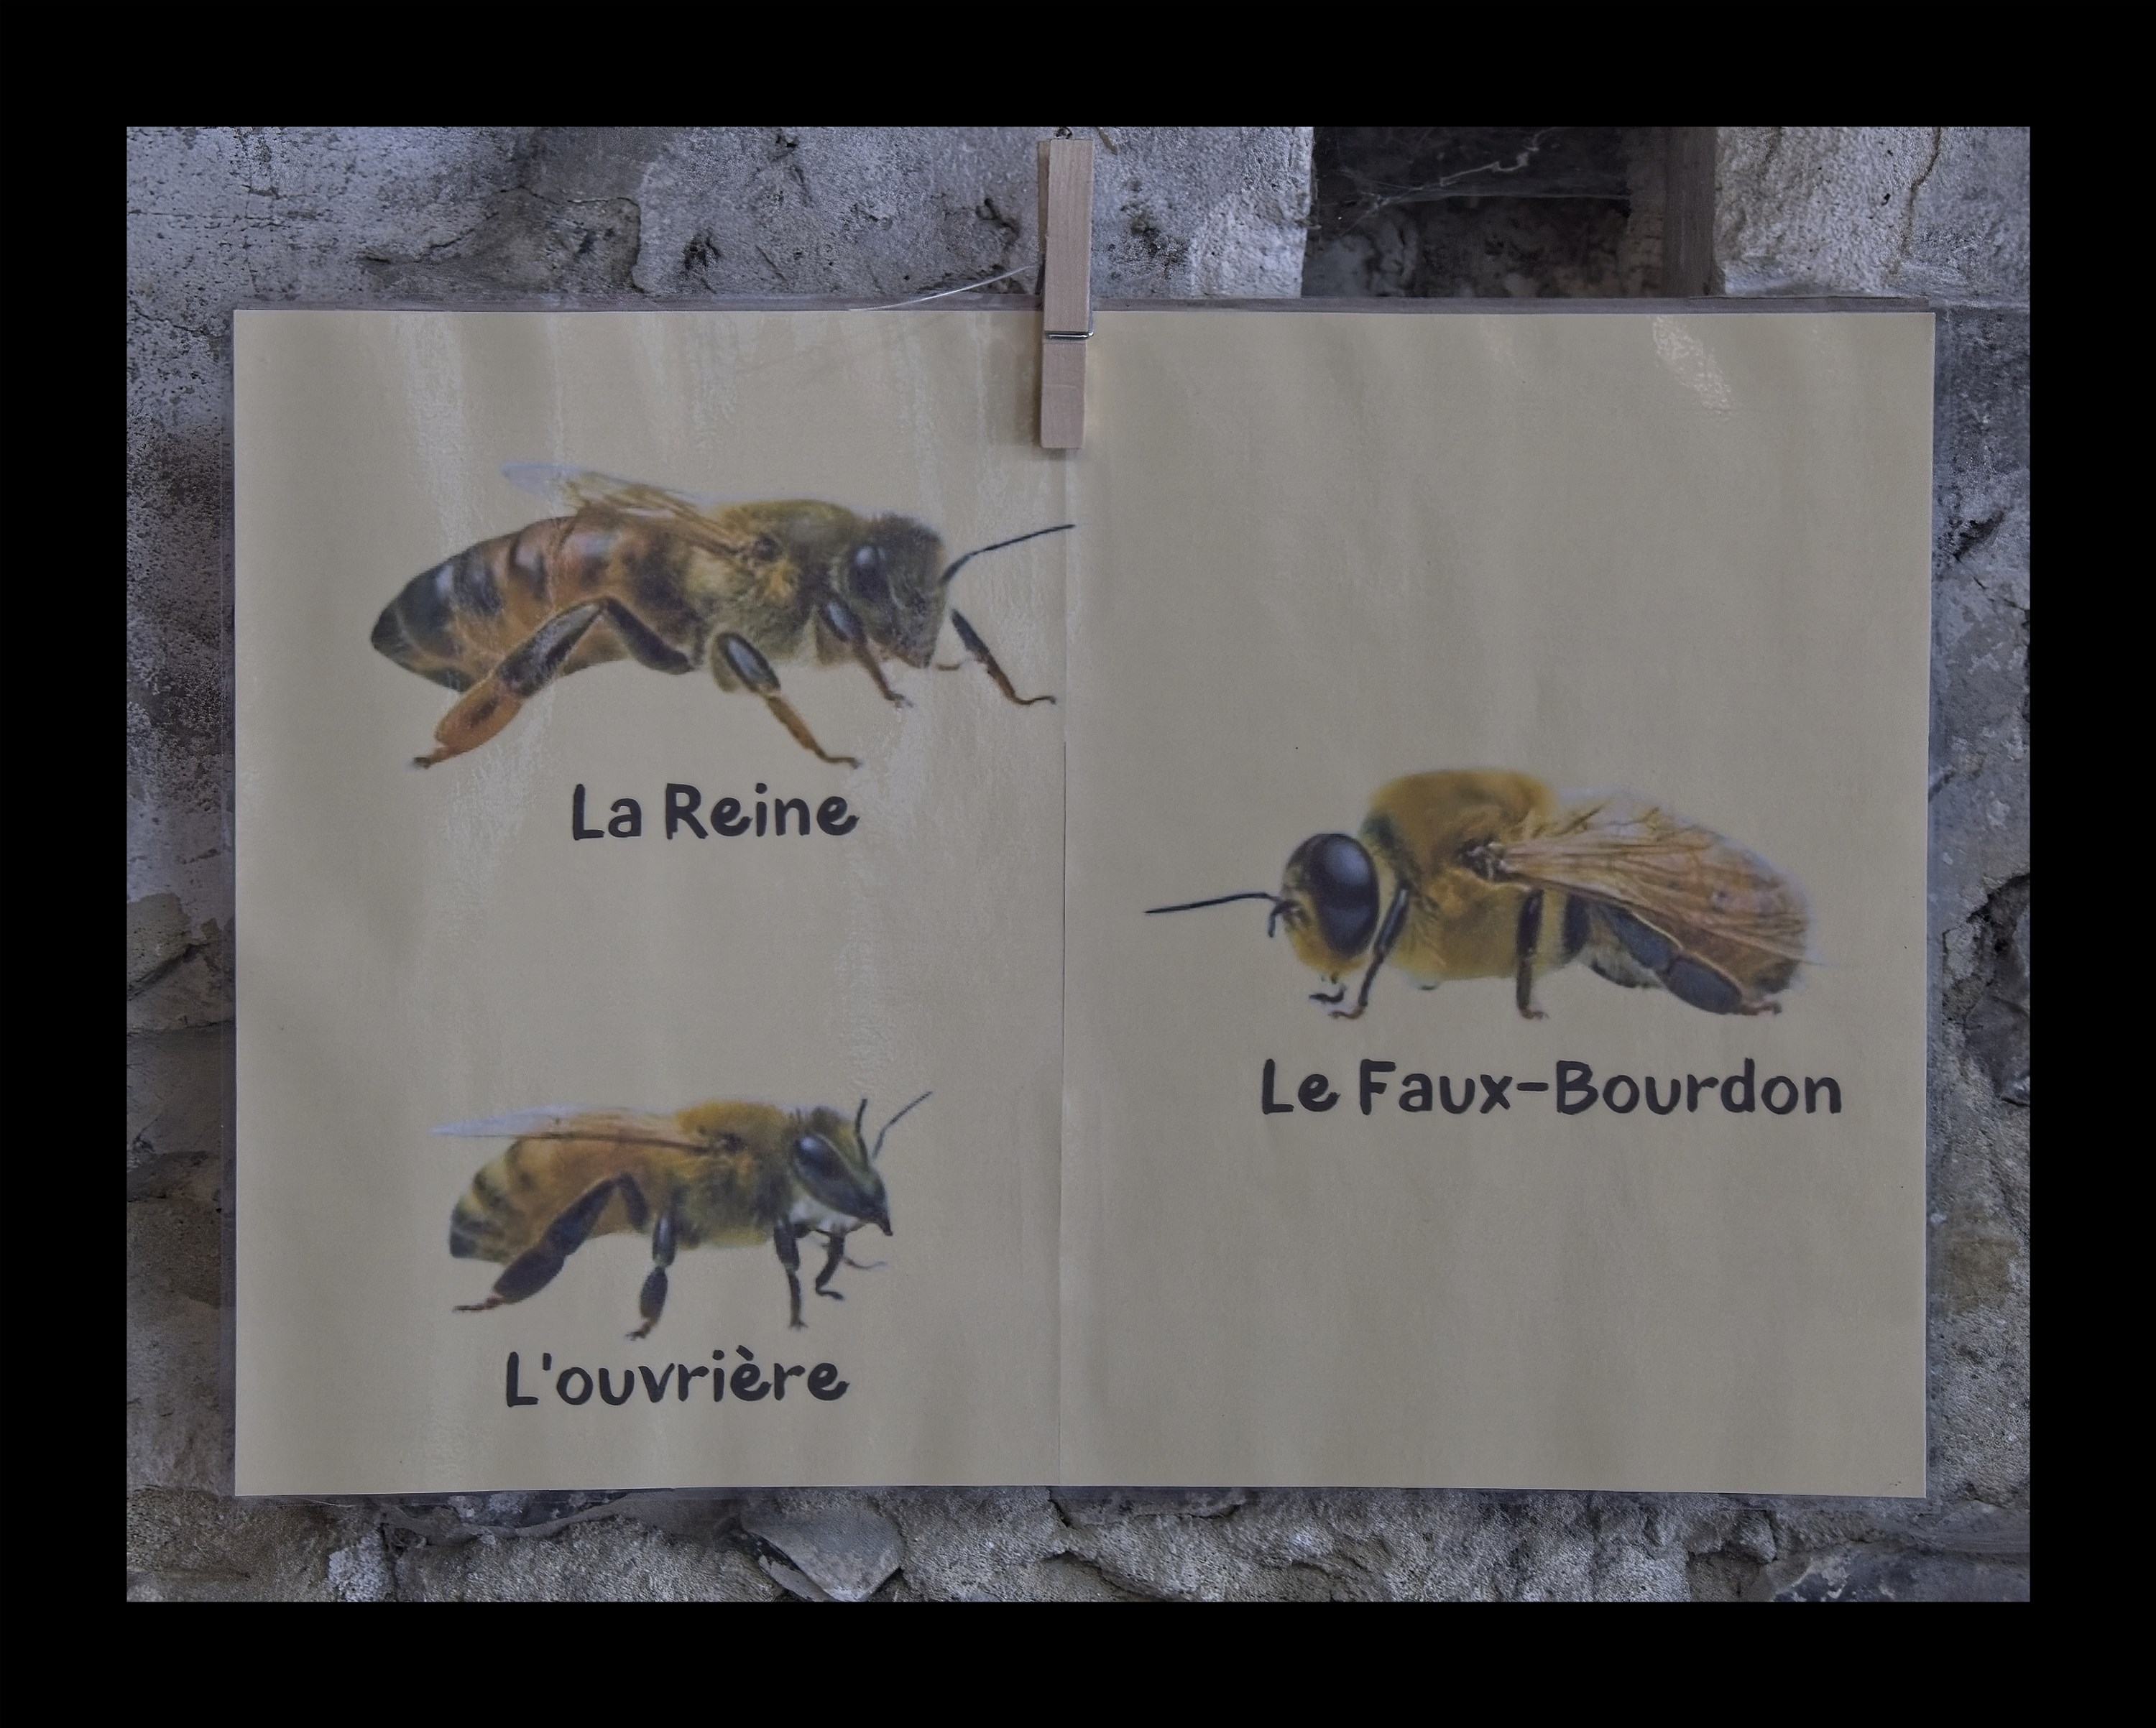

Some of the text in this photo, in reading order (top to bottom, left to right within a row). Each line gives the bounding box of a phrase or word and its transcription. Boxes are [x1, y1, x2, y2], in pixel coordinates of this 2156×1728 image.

[572, 782, 860, 841] La Reine
[1262, 1057, 1842, 1115] Le Faux-Bourdon
[506, 1344, 850, 1408] L'ouvrière
